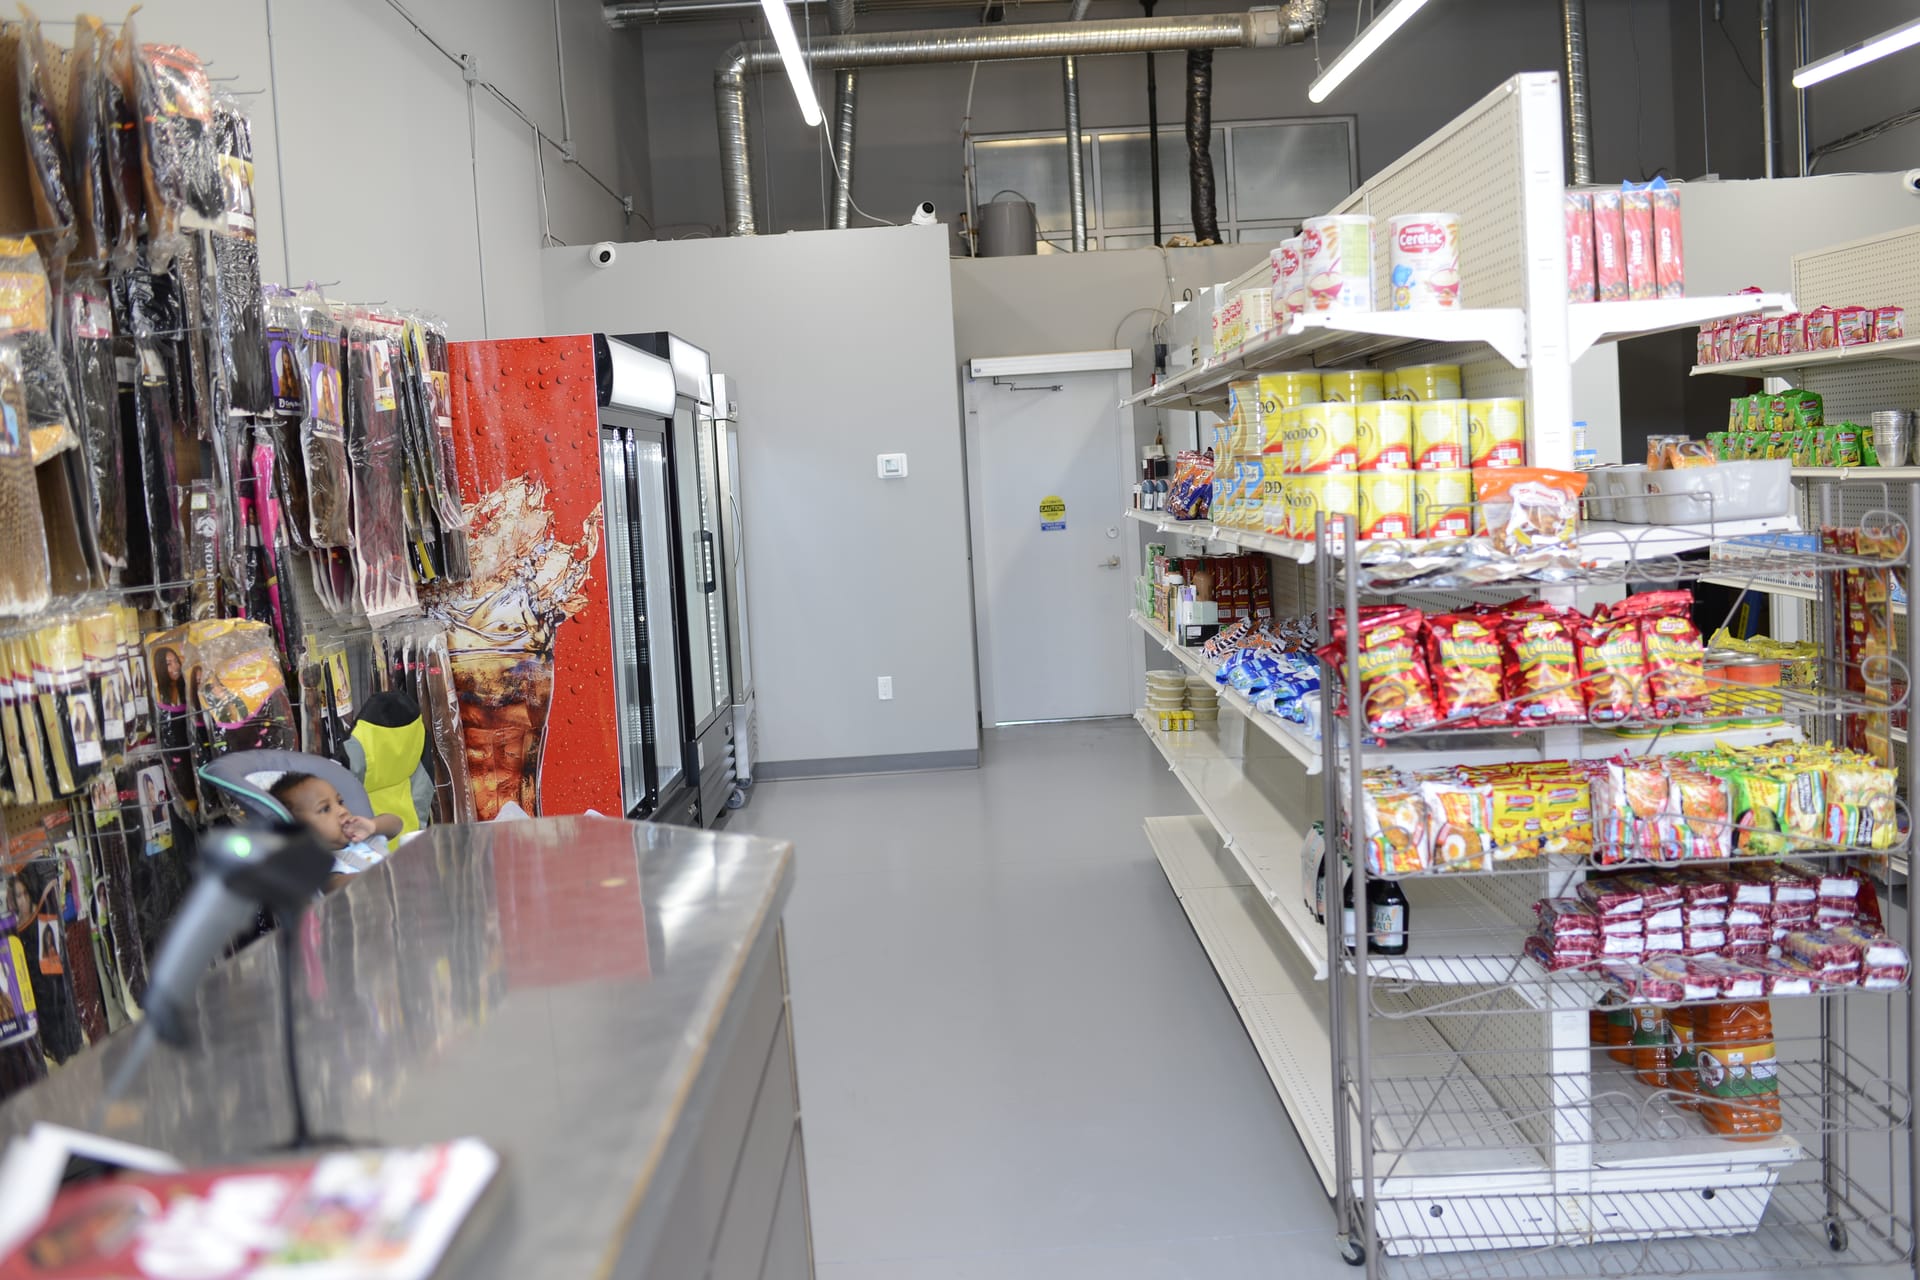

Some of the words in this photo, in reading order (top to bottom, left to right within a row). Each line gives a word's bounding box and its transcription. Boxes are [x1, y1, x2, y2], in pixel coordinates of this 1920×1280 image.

[1571, 235, 1582, 270] CABIN
[1602, 232, 1614, 268] CABIN
[1631, 229, 1642, 265] CABIN
[1661, 227, 1671, 263] CABIN
[204, 542, 215, 599] MODERN
